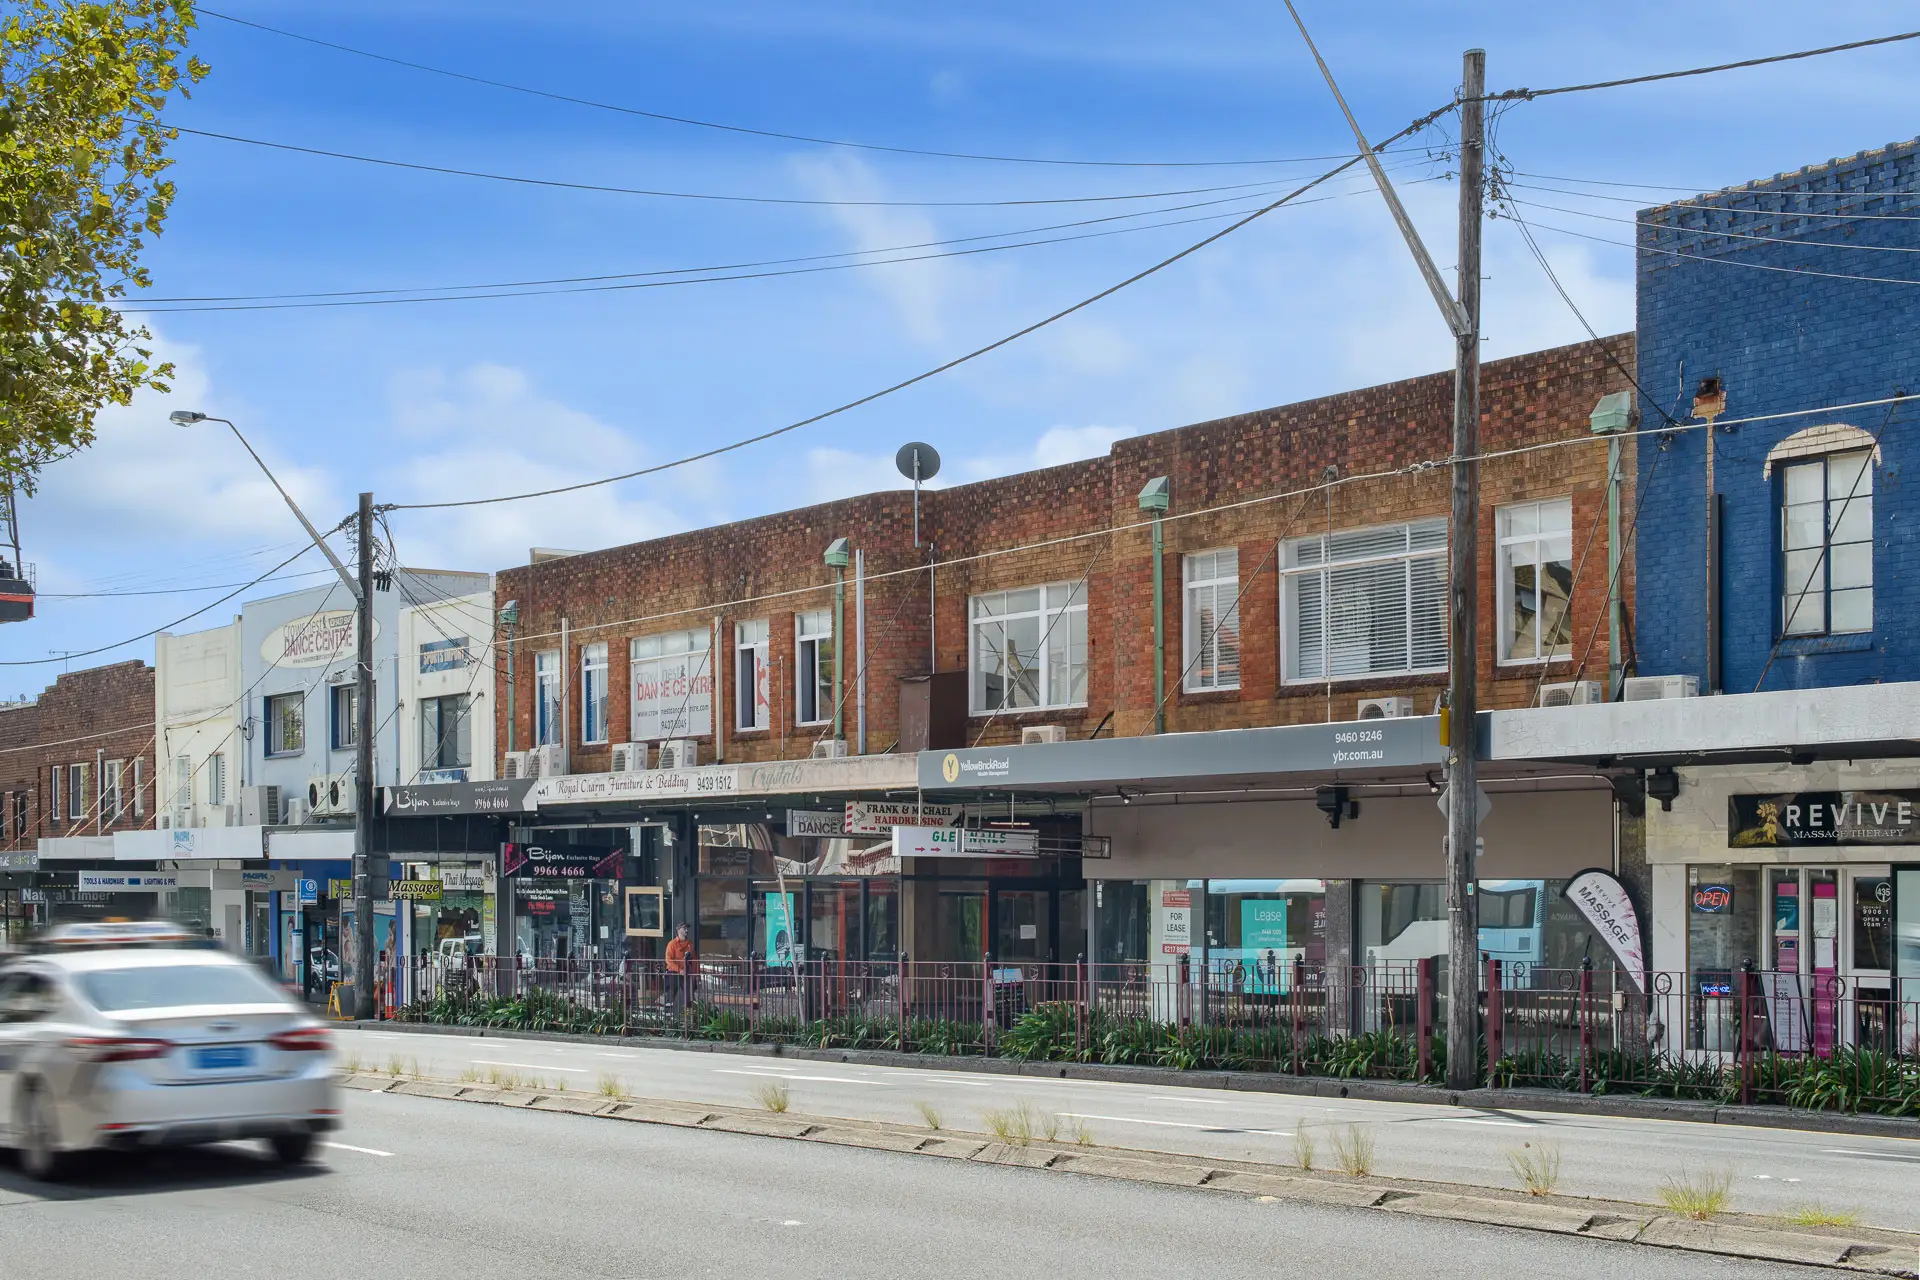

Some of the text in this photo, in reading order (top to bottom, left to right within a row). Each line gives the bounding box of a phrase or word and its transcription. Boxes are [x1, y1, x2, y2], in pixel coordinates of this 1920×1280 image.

[284, 626, 352, 657] DANCE CENTRE
[1335, 730, 1382, 743] 9460 9246
[1332, 749, 1383, 764] ybr.com.au
[960, 757, 1009, 771] YellowBrickRoad
[556, 780, 579, 799] Royal
[608, 777, 643, 796] Furniture
[645, 778, 653, 789] &
[655, 774, 689, 792] Bedding
[697, 777, 714, 791] 9439
[715, 775, 732, 789] 1512
[396, 790, 429, 811] Bijan
[867, 804, 952, 816] FRANK & MCHAEL
[1786, 801, 1912, 827] REVIVE
[798, 822, 838, 834] DANCE
[1794, 828, 1905, 839] MASSAGE THERAPY
[931, 830, 956, 842] GLE
[526, 847, 565, 863] Bijan
[533, 866, 585, 876] 9966 4666
[83, 878, 97, 886] TOOLS
[102, 878, 125, 886] HARDWARE
[144, 878, 163, 886] LIGHTING
[168, 878, 176, 886] PPE
[444, 872, 484, 888] Thai Massage
[22, 888, 66, 901] Natal
[388, 881, 439, 897] Massage
[1877, 887, 1891, 896] 435
[391, 892, 423, 900] 5615
[1694, 891, 1730, 906] OPEN
[1170, 912, 1183, 921] FOR
[1254, 908, 1282, 922] Lease
[1578, 886, 1630, 944] MASSAGE
[1166, 923, 1186, 932] LEASE
